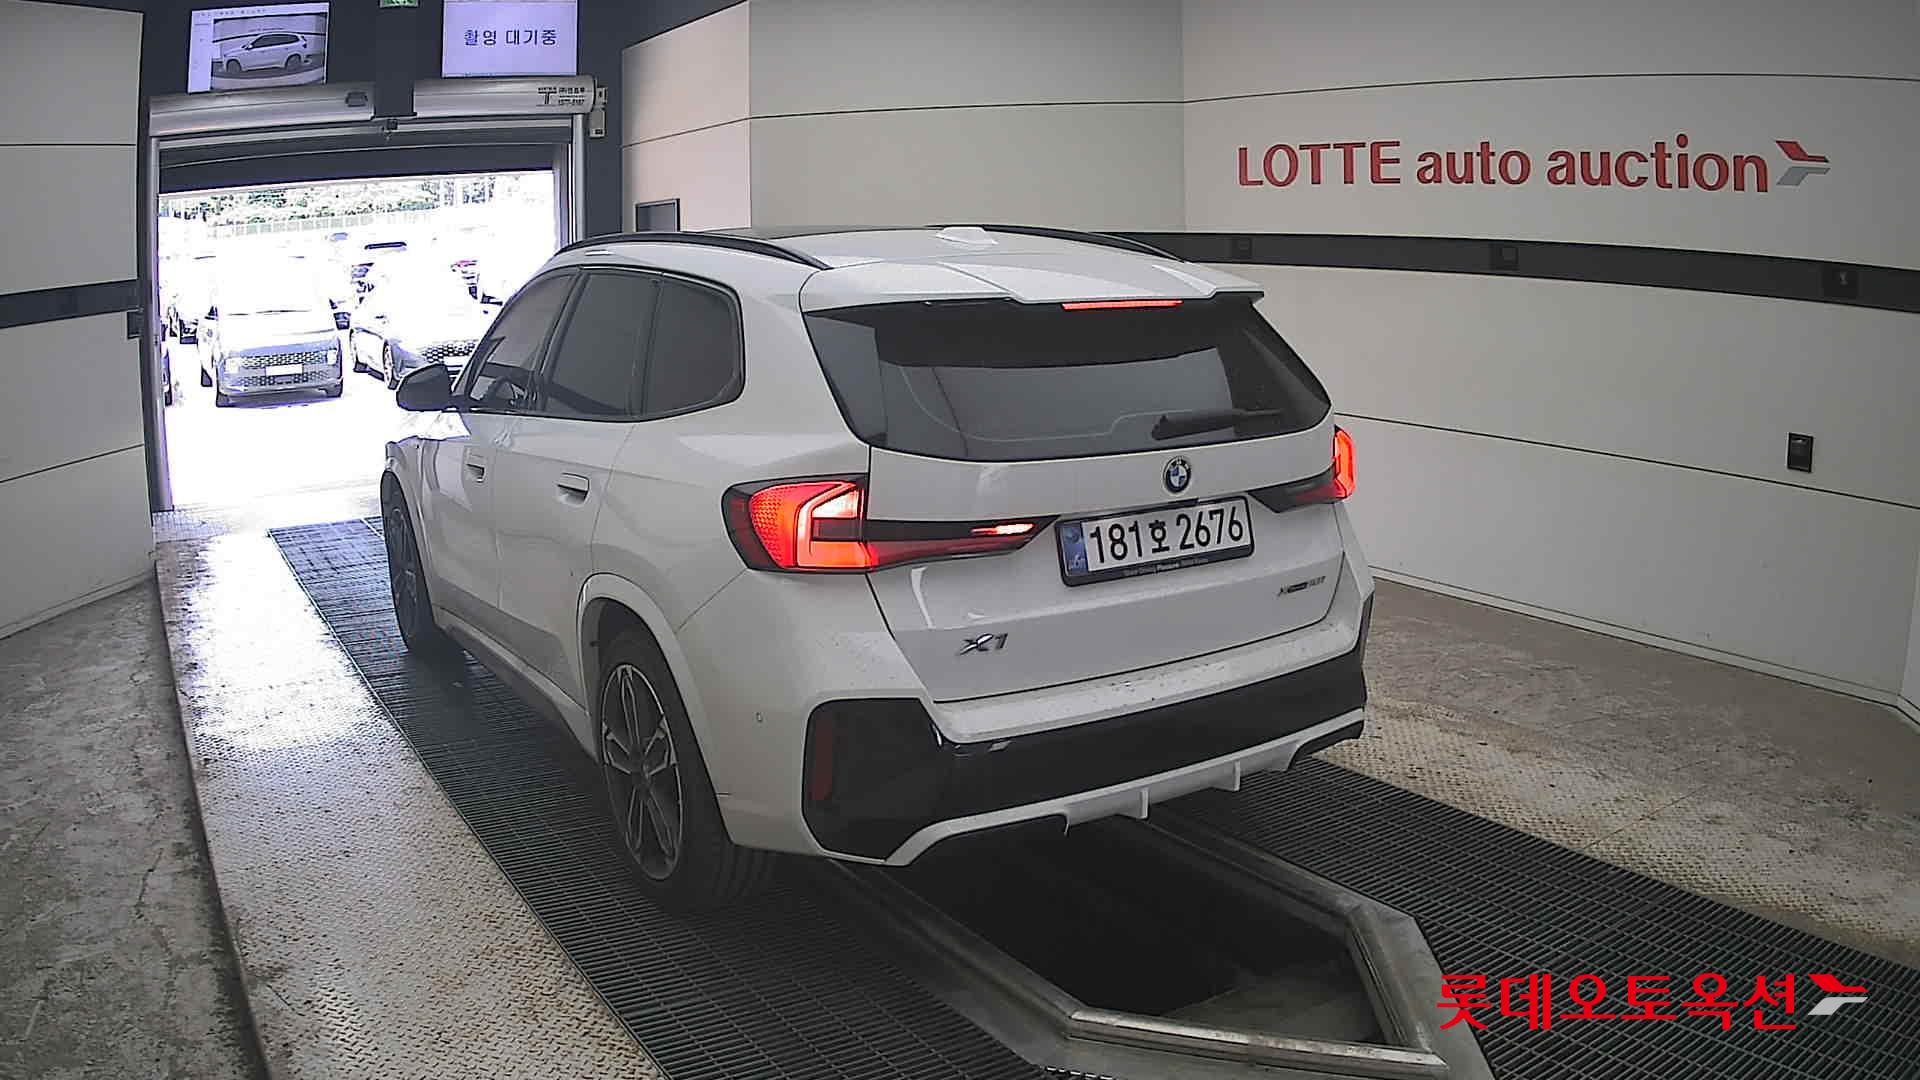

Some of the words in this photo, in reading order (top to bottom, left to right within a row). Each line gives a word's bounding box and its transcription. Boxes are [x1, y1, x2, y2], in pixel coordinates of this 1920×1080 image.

[463, 28, 497, 46] 촬영
[505, 28, 557, 46] 대기중
[1238, 140, 1401, 188] LOTTE
[1416, 141, 1532, 185] auto
[1546, 133, 1769, 193] auction
[1175, 506, 1244, 551] 2676
[957, 632, 1009, 656] X1
